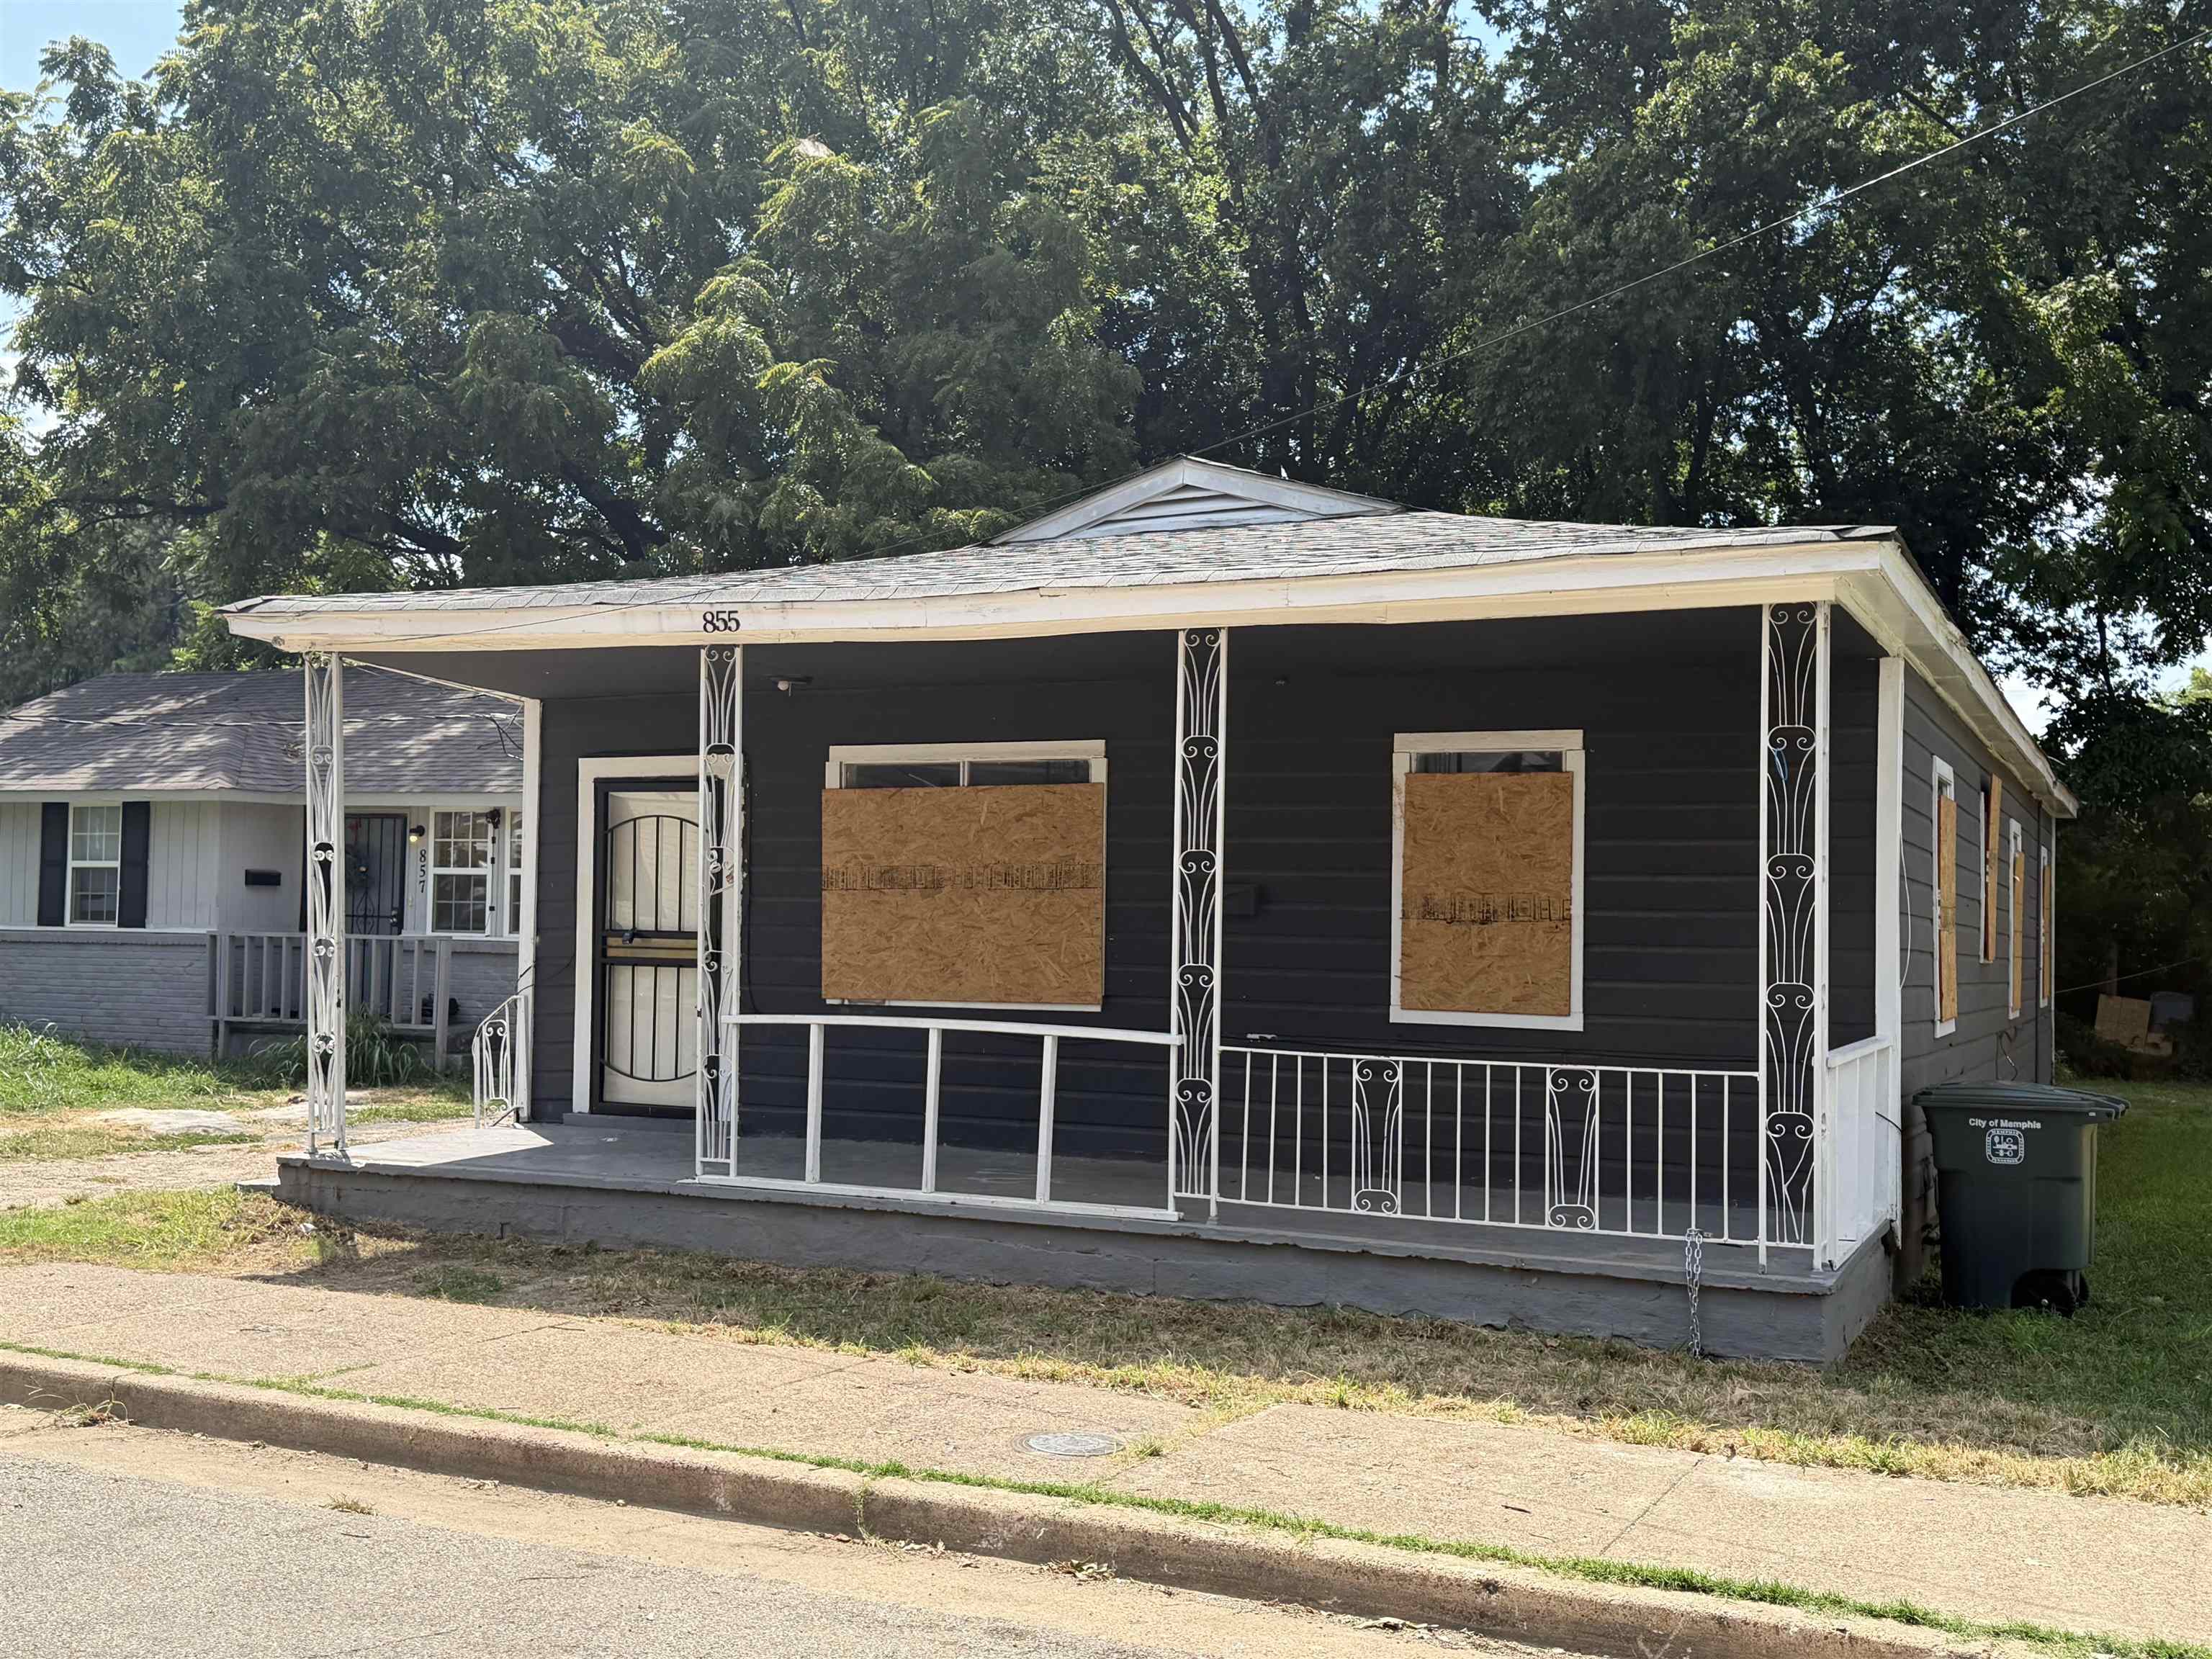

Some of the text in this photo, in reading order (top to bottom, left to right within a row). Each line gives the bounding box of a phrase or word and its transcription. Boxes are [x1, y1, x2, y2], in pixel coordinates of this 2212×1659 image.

[703, 610, 740, 634] 855
[1969, 1118, 1987, 1128] City
[2000, 1120, 2041, 1130] Memphis
